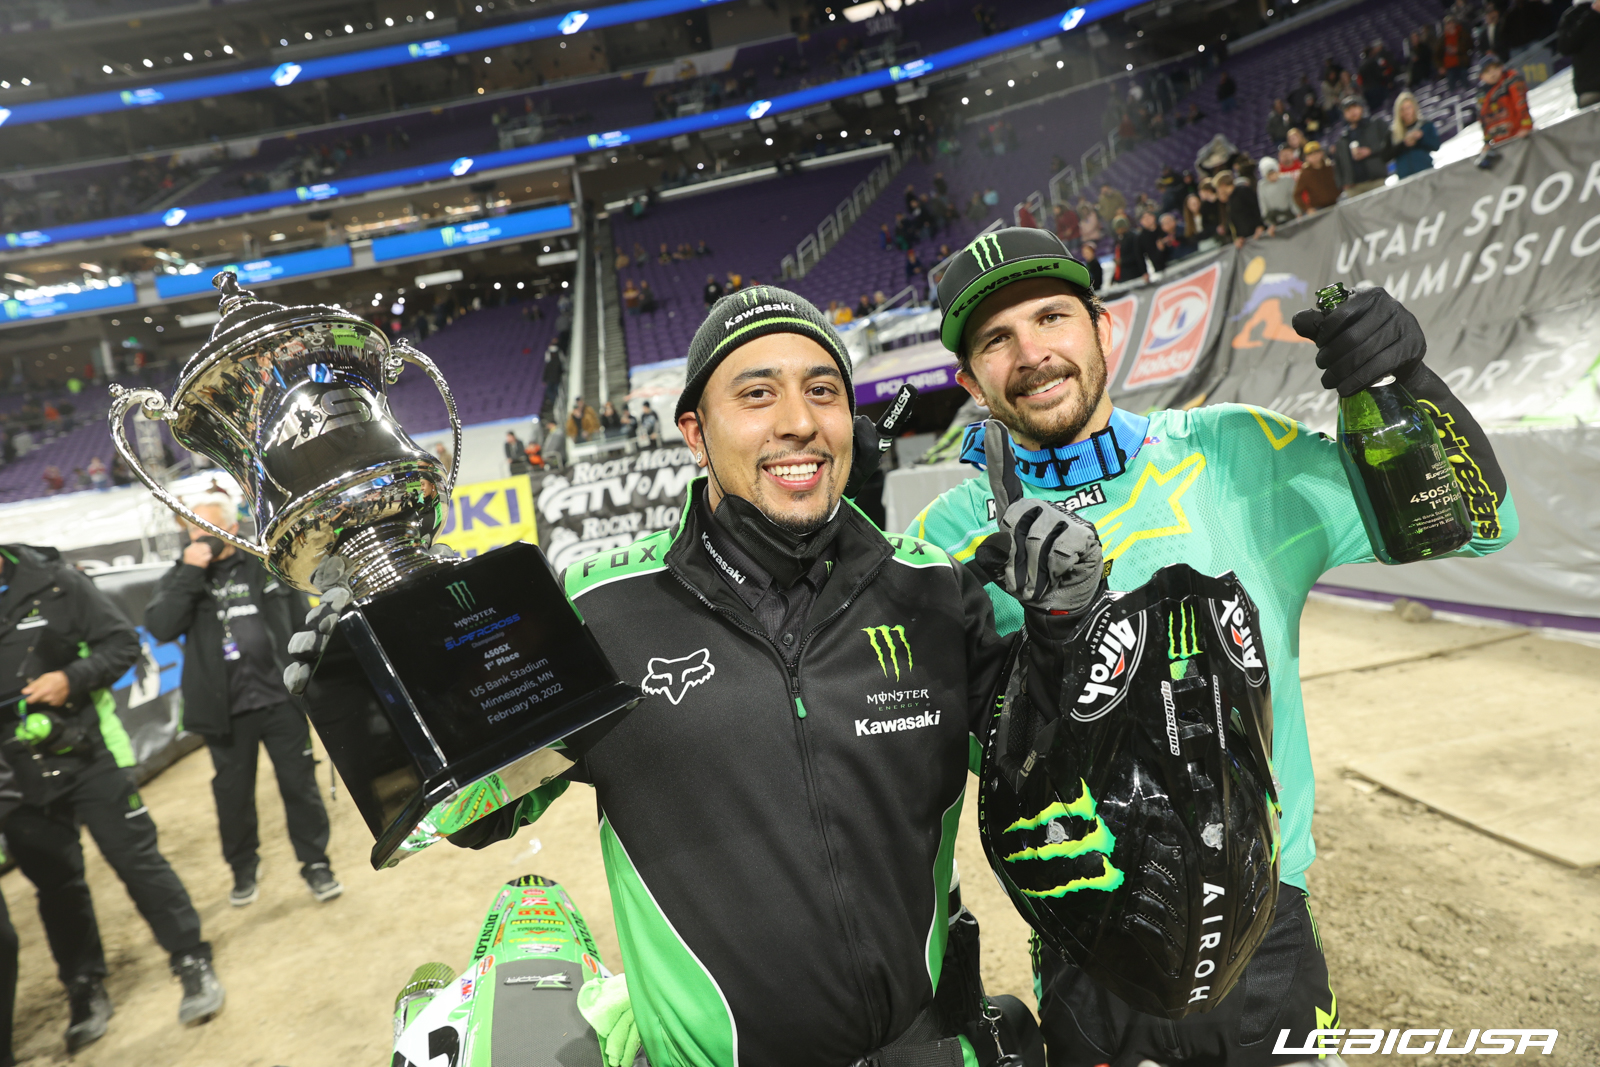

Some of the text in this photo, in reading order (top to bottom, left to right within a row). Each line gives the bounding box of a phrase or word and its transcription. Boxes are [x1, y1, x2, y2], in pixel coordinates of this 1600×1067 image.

[1336, 210, 1447, 275] UTAH
[1354, 213, 1600, 303] MMISSIO
[952, 262, 1060, 318] Kawasaki
[724, 302, 795, 330] Kawasaki
[883, 387, 911, 430] ASTARS
[572, 459, 635, 486] ROCKY
[1410, 483, 1451, 503] 450SX
[582, 512, 643, 541] ROCKY
[583, 544, 658, 578] FOX
[701, 531, 747, 585] Kawasaki
[887, 536, 928, 556] OX
[444, 613, 521, 651] SUPERCROSS
[484, 643, 511, 659] 450SX
[496, 652, 520, 667] Place
[1077, 618, 1137, 704] Airoh
[469, 657, 549, 698] US Bank Stadium
[480, 670, 555, 711] Minneapolis, MN
[486, 682, 564, 725] February 19, 2022
[866, 688, 930, 706] MONSTER
[878, 701, 921, 712] ENERGY
[854, 709, 942, 737] Kawasaki
[1187, 882, 1226, 1004] AIROH
